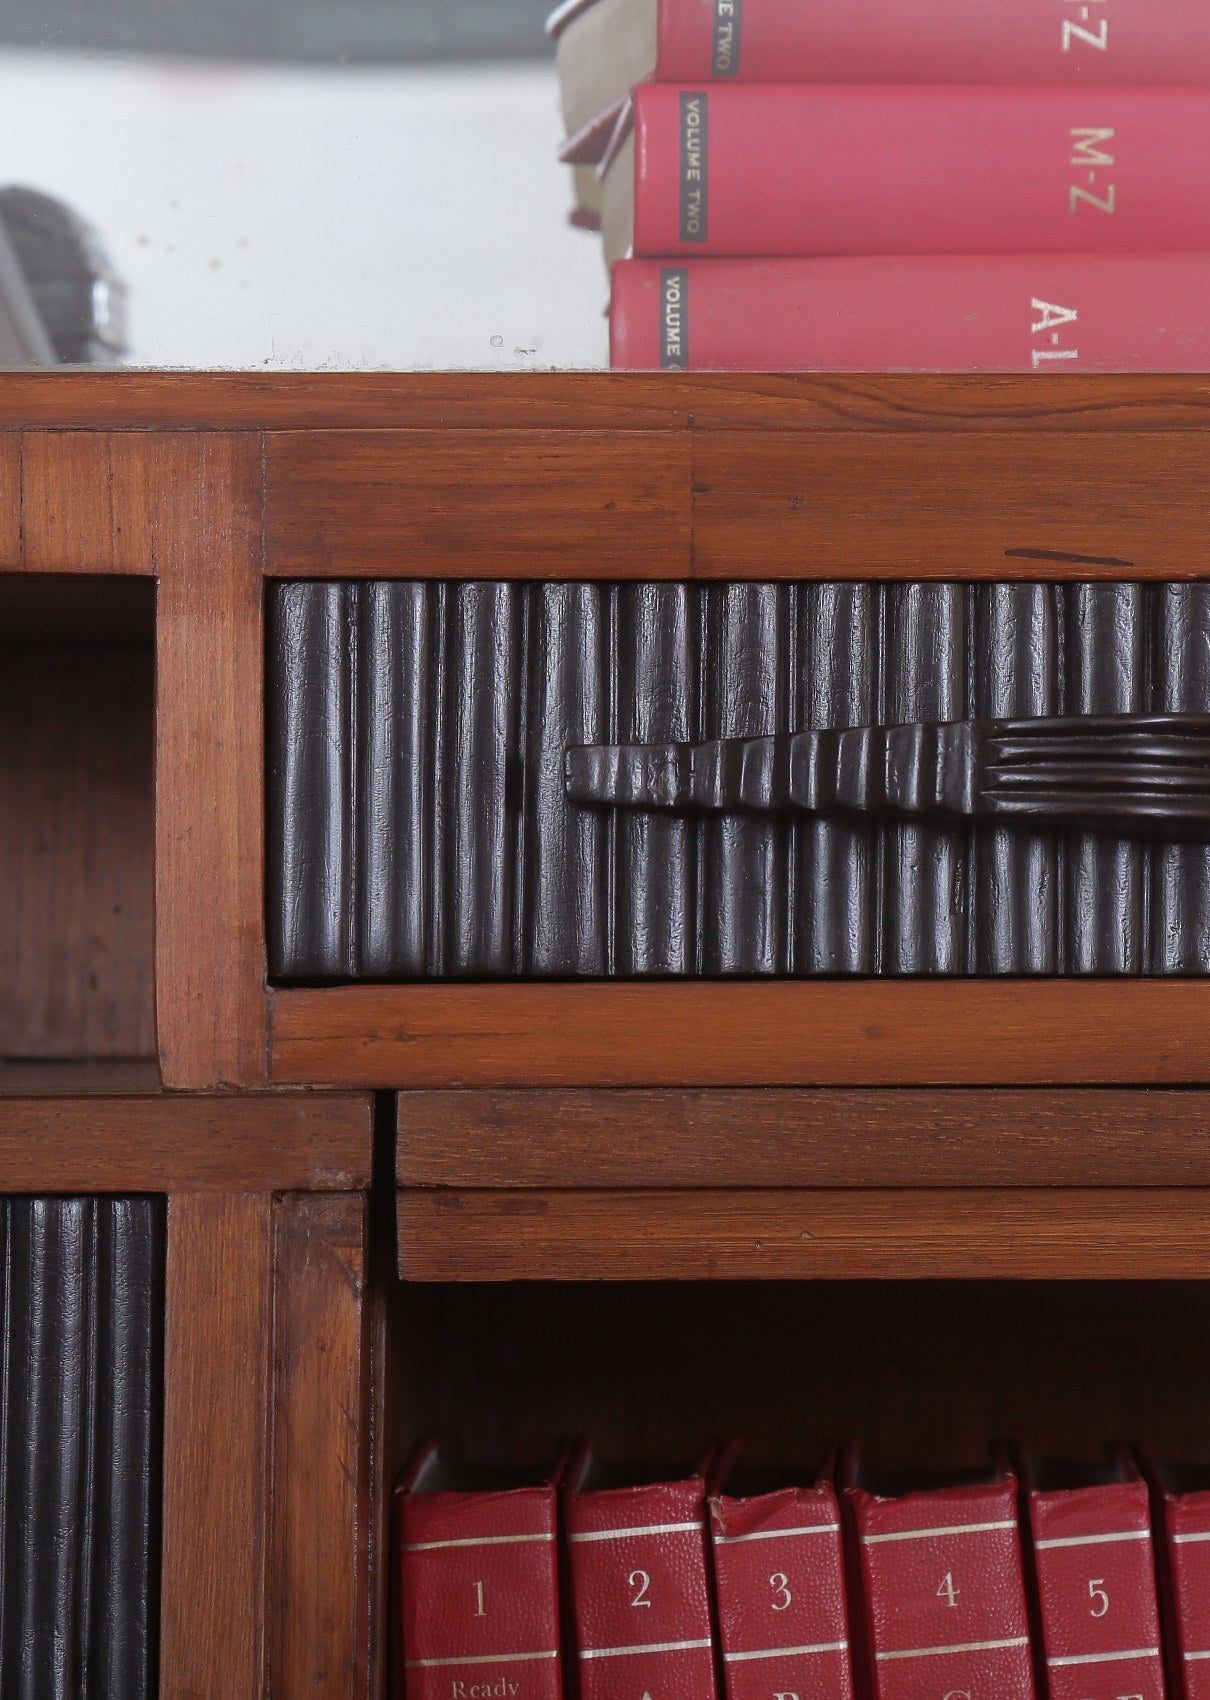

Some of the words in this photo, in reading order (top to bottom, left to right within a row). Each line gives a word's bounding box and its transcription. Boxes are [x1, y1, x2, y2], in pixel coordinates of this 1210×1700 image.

[717, 22, 733, 71] TWO
[1061, 0, 1108, 51] -Z
[686, 99, 700, 181] VOLUME
[1070, 127, 1114, 214] M-Z
[687, 188, 700, 234] TWO
[666, 276, 681, 357] VOLUME
[1031, 297, 1079, 369] A-L
[473, 1580, 487, 1616] 1
[628, 1570, 652, 1607] 2
[769, 1572, 793, 1610] 3
[936, 1572, 960, 1607] 4
[1088, 1579, 1109, 1617] 5
[452, 1677, 520, 1700] Ready
